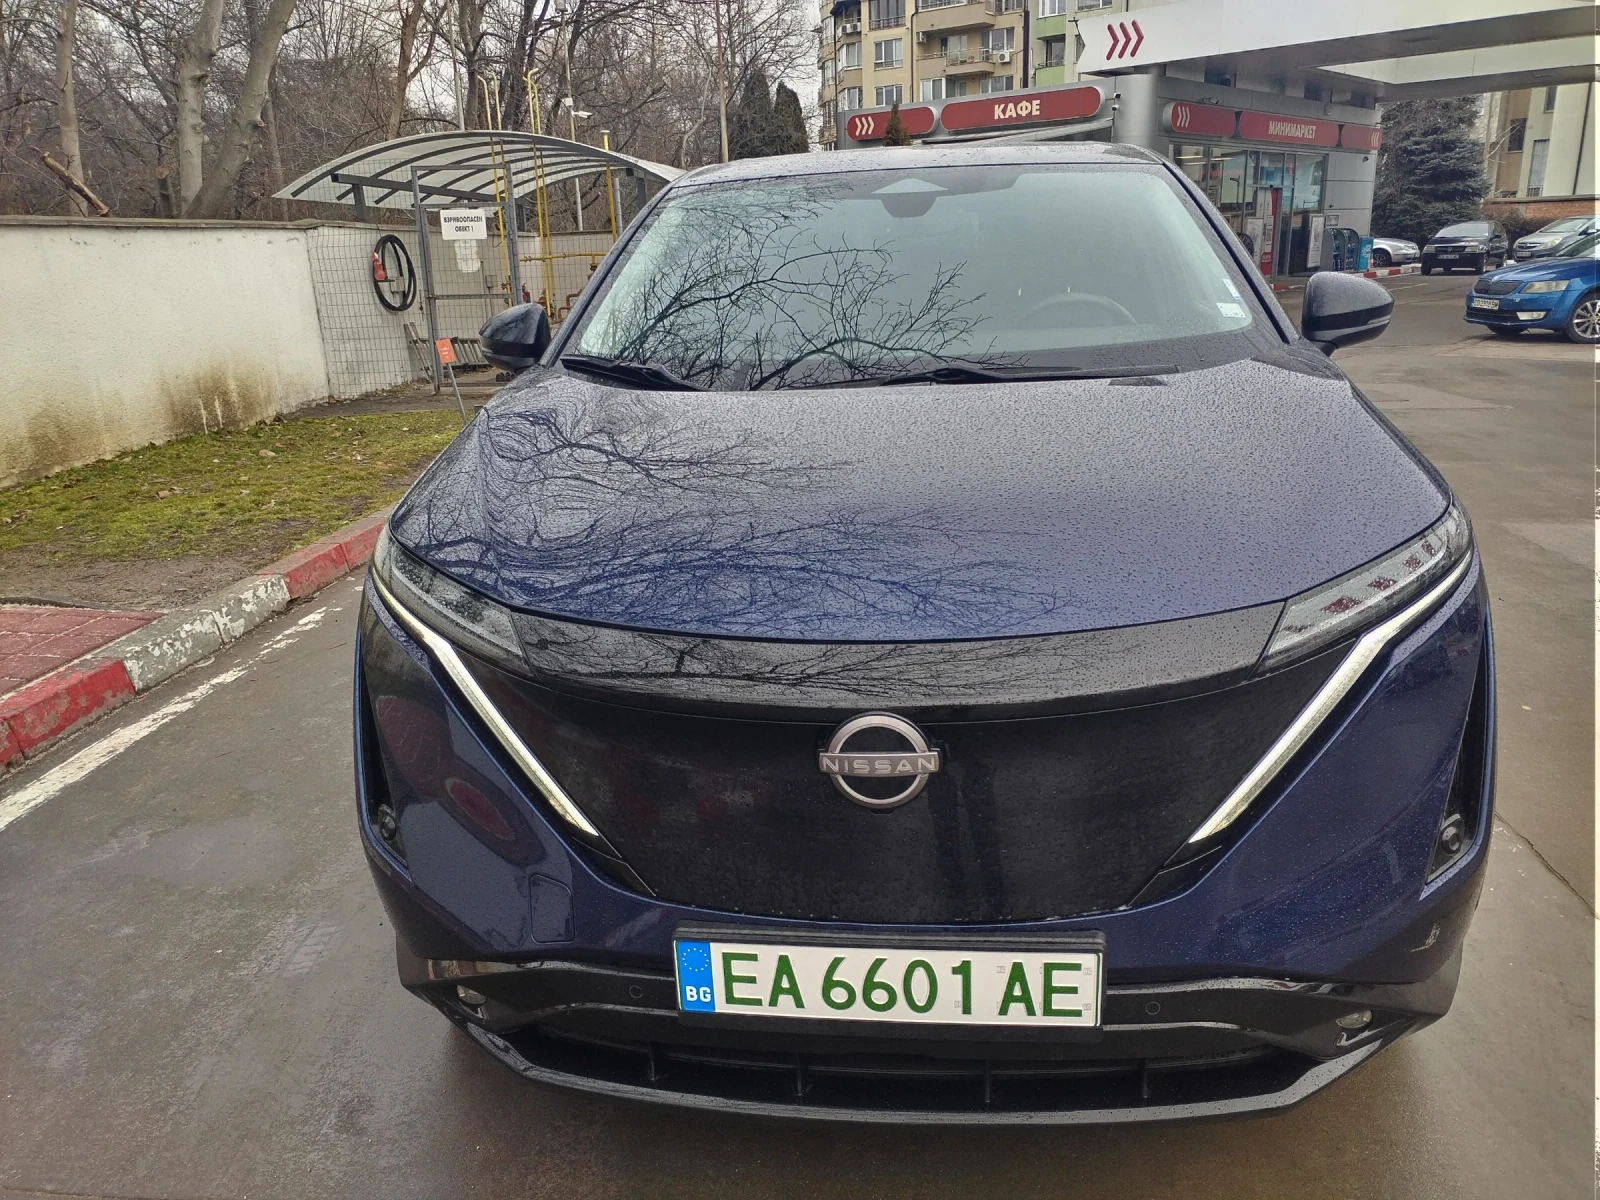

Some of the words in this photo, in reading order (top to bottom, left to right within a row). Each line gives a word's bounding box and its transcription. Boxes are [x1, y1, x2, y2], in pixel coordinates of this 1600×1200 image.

[994, 99, 1041, 120] КАФЕ
[1268, 120, 1317, 139] МИНИМАРКЕТ
[822, 757, 937, 774] NISSAN
[722, 951, 806, 1009] EA
[821, 956, 972, 1015] 6601
[998, 961, 1083, 1017] AE
[686, 985, 712, 1003] BG
